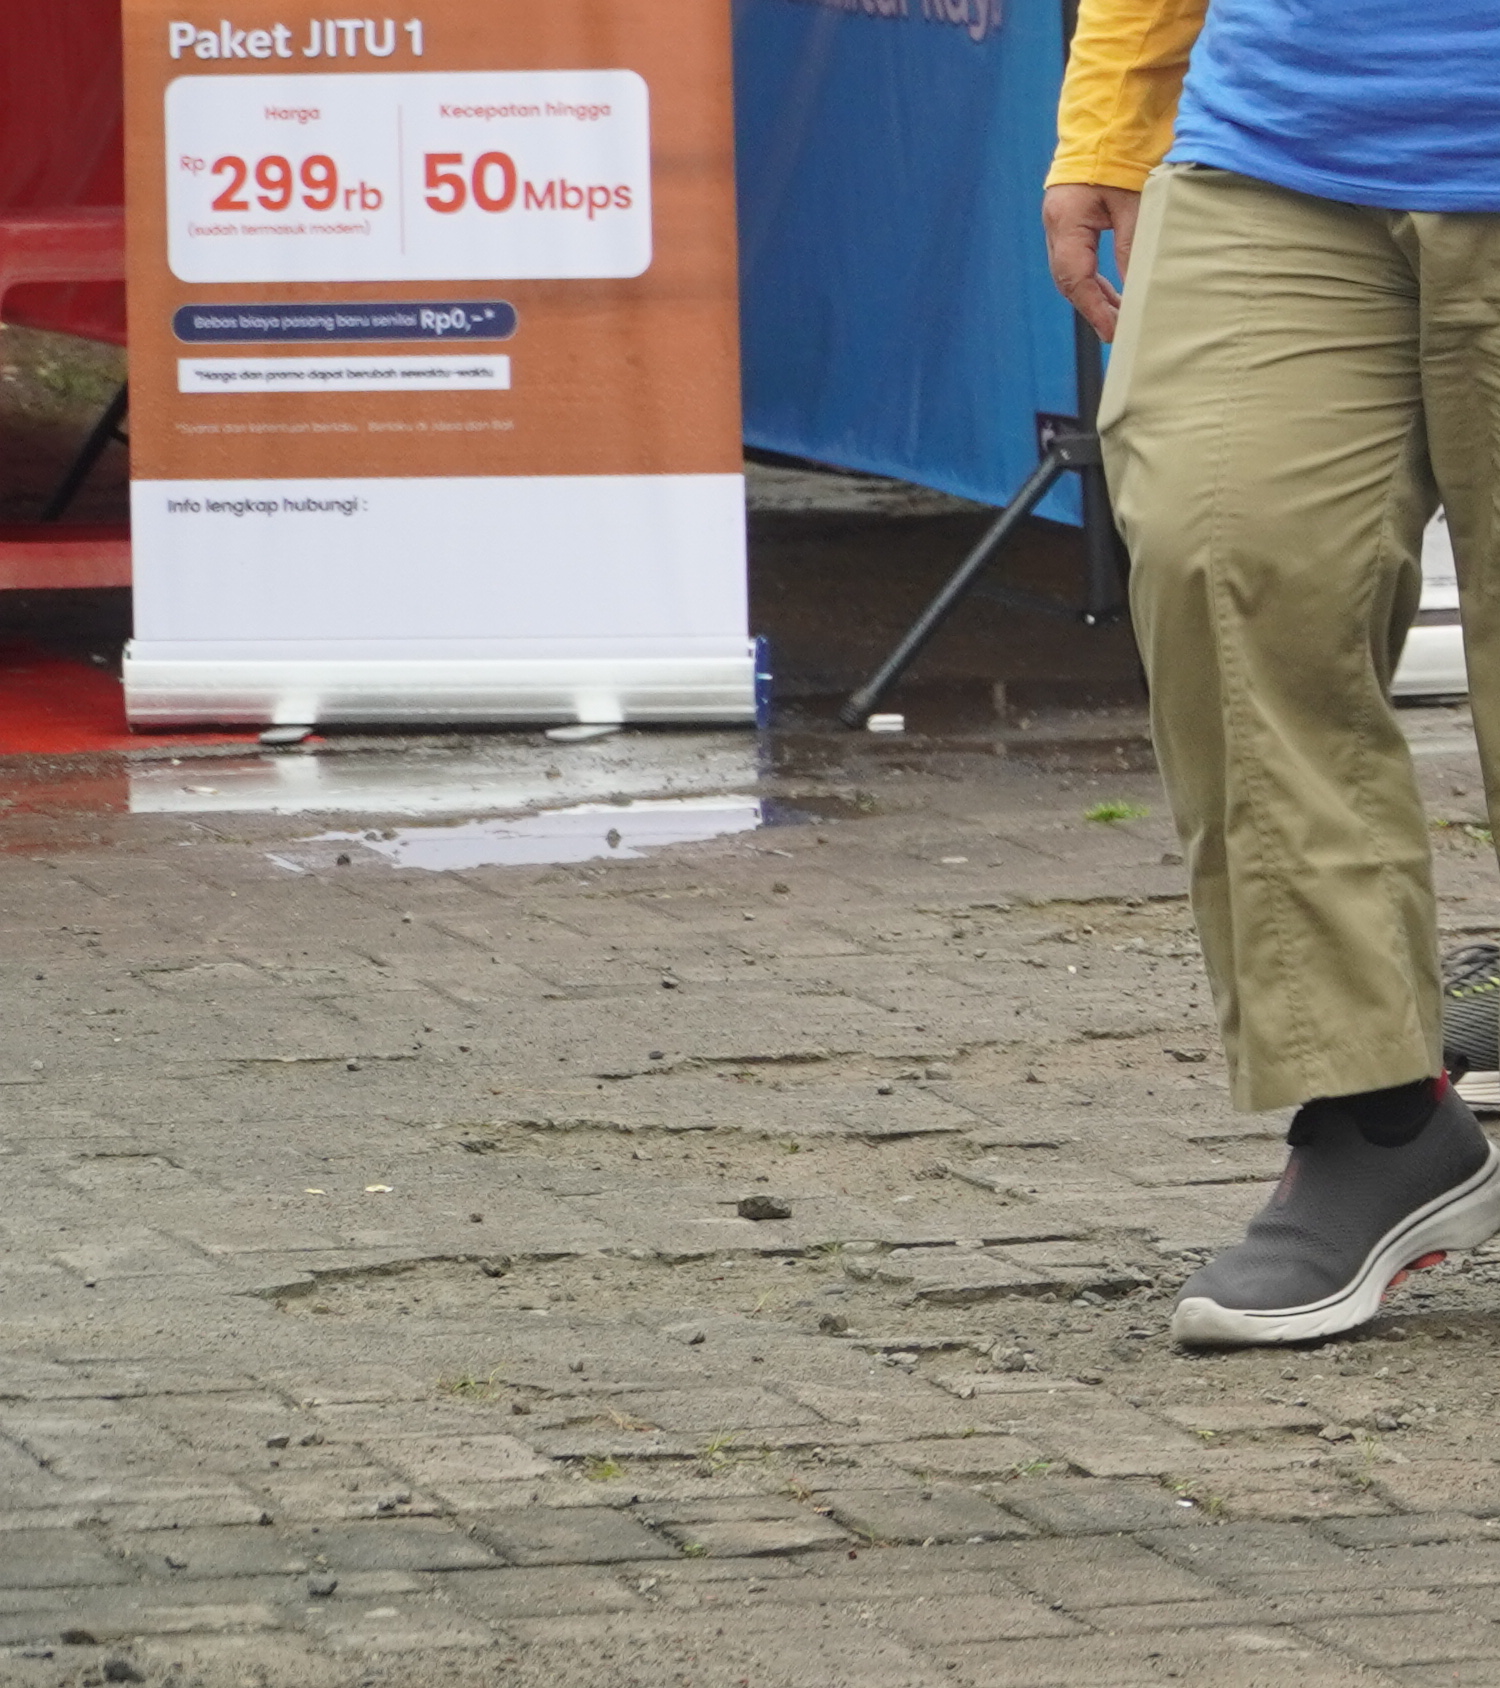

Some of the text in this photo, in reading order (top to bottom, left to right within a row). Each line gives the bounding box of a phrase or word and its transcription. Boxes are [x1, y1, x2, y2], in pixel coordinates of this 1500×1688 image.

[169, 17, 424, 60] Paket JITU 1
[265, 100, 612, 124] Harga Kecepatan hingga
[180, 155, 205, 177] Rp
[167, 496, 200, 515] Info
[205, 496, 278, 520] lengkap
[282, 495, 359, 518] hubungi
